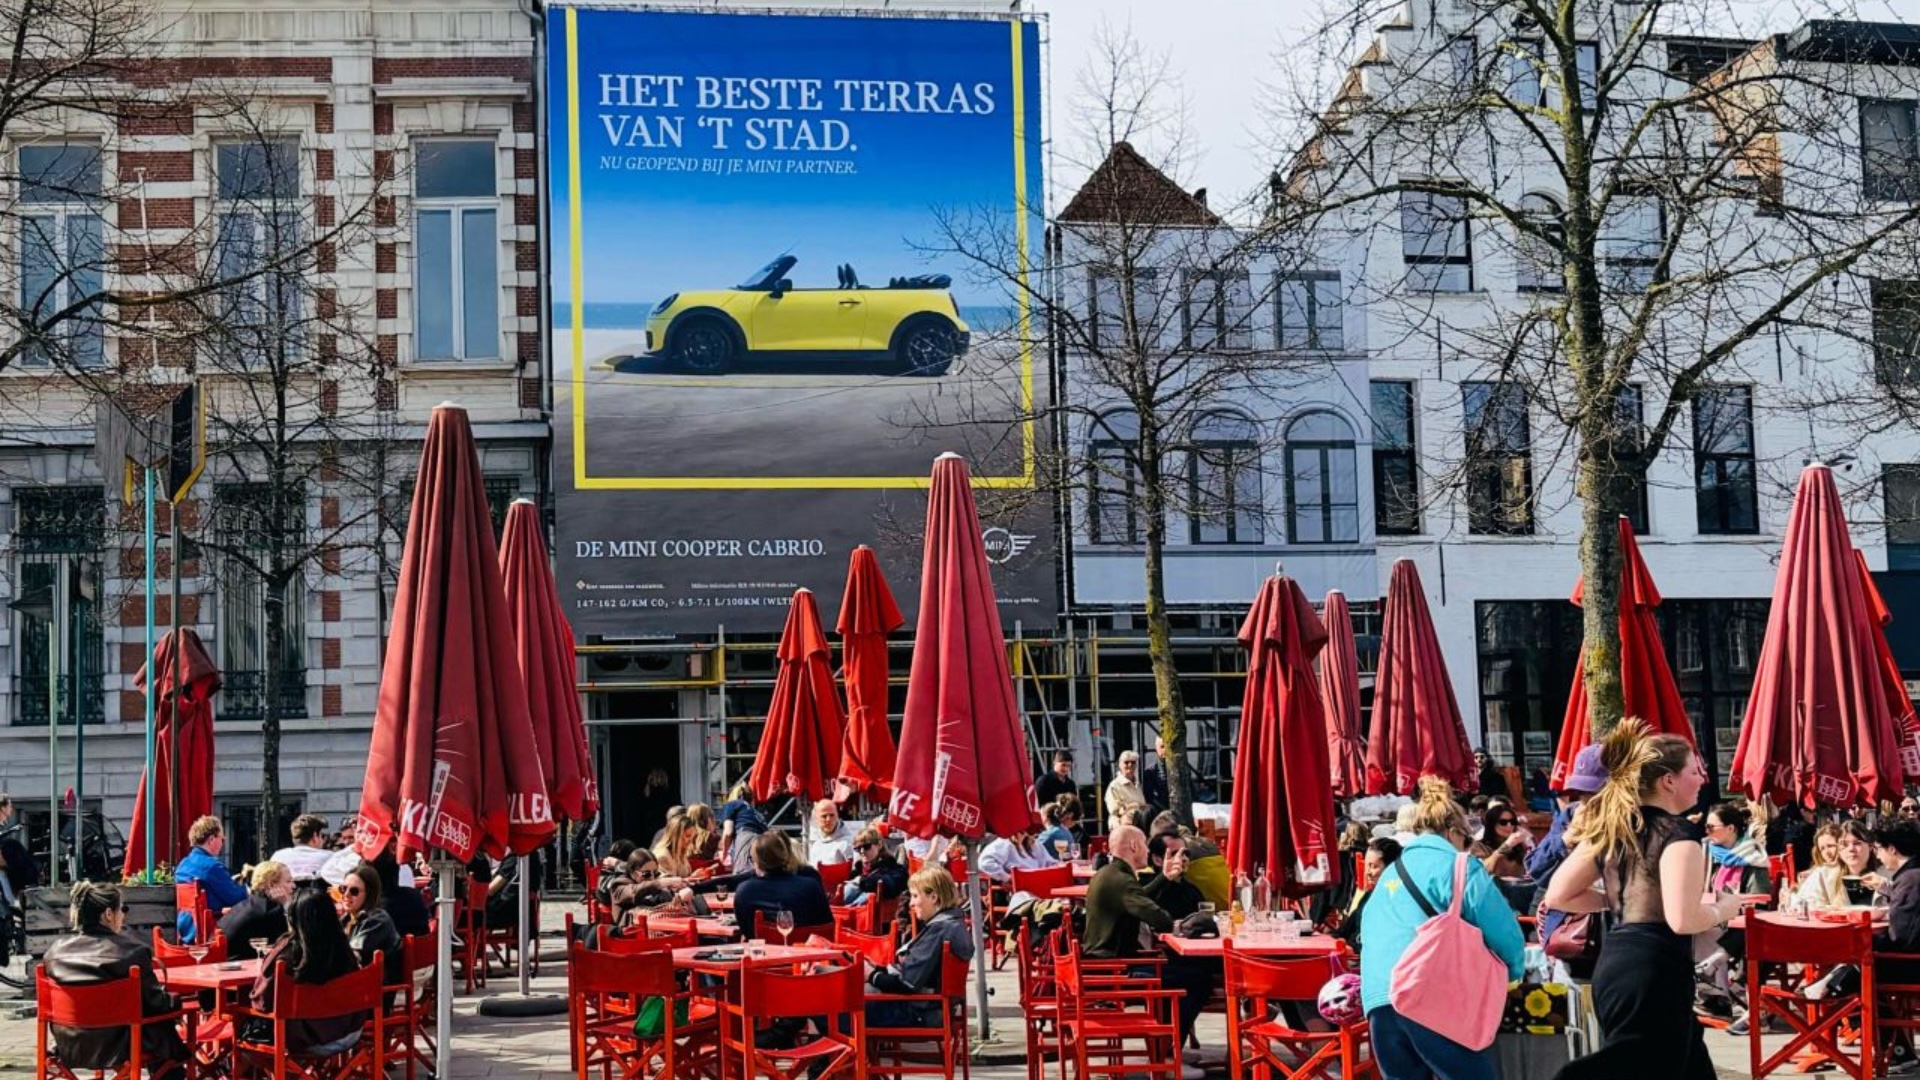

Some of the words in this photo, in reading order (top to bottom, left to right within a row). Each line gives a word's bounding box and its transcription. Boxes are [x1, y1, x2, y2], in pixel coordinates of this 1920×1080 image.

[598, 74, 684, 108] HET
[695, 76, 823, 111] BESTE
[833, 80, 996, 115] TERRAS
[598, 114, 685, 148] VAN
[745, 117, 858, 152] STAD.
[599, 155, 622, 170] NU
[625, 156, 699, 172] GEOPEND
[702, 158, 724, 175] BIJ
[726, 158, 744, 175] JE
[747, 159, 782, 174] MINI
[785, 159, 858, 175] PARTNER.
[575, 541, 604, 558] DE
[608, 540, 657, 558] MINI
[662, 539, 744, 557] COOPER
[747, 539, 828, 557] CABRIO.
[576, 599, 616, 609] 147-162
[619, 598, 648, 608] G/KM
[678, 597, 711, 608] 6.5-7.1
[714, 597, 760, 607] L/100KM
